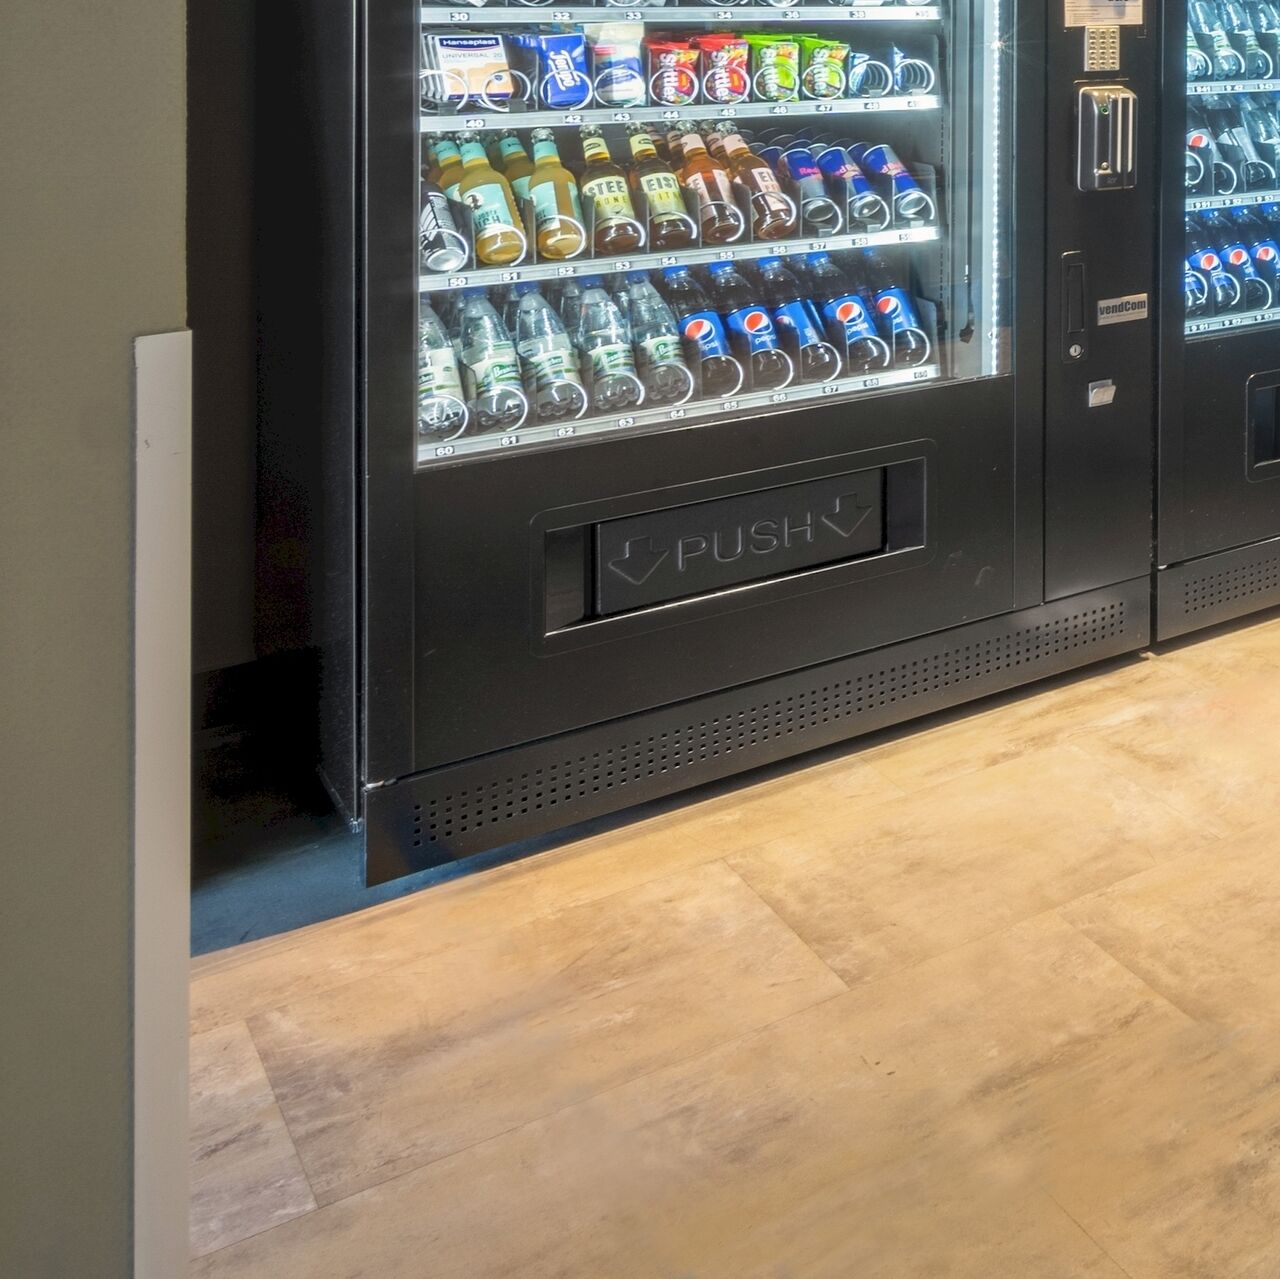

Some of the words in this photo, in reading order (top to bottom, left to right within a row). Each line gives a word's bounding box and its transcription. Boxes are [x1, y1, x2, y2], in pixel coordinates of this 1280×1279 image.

[452, 12, 469, 21] 30
[555, 12, 570, 20] 32
[626, 12, 642, 20] 33
[717, 11, 732, 19] 34
[784, 11, 800, 19] 36
[442, 38, 498, 46] Hansaplast
[550, 50, 580, 91] Tempo
[467, 120, 484, 128] 40
[566, 115, 581, 123] 42
[615, 113, 630, 121] 43
[664, 111, 679, 119] 44
[772, 106, 787, 114] 46
[449, 277, 466, 286] 50
[503, 273, 518, 281] 51
[559, 267, 574, 275] 52
[615, 261, 630, 270] 53
[661, 257, 676, 265] 54
[720, 252, 734, 260] 55
[773, 246, 787, 254] 56
[812, 242, 826, 250] 57
[1099, 300, 1146, 315] vendCom
[436, 446, 454, 455] 60
[502, 436, 517, 445] 61
[559, 427, 574, 435] 62
[618, 418, 633, 426] 63
[670, 409, 685, 418] 64
[723, 401, 738, 410] 65
[772, 394, 787, 402] 66
[678, 511, 814, 572] PUSH
